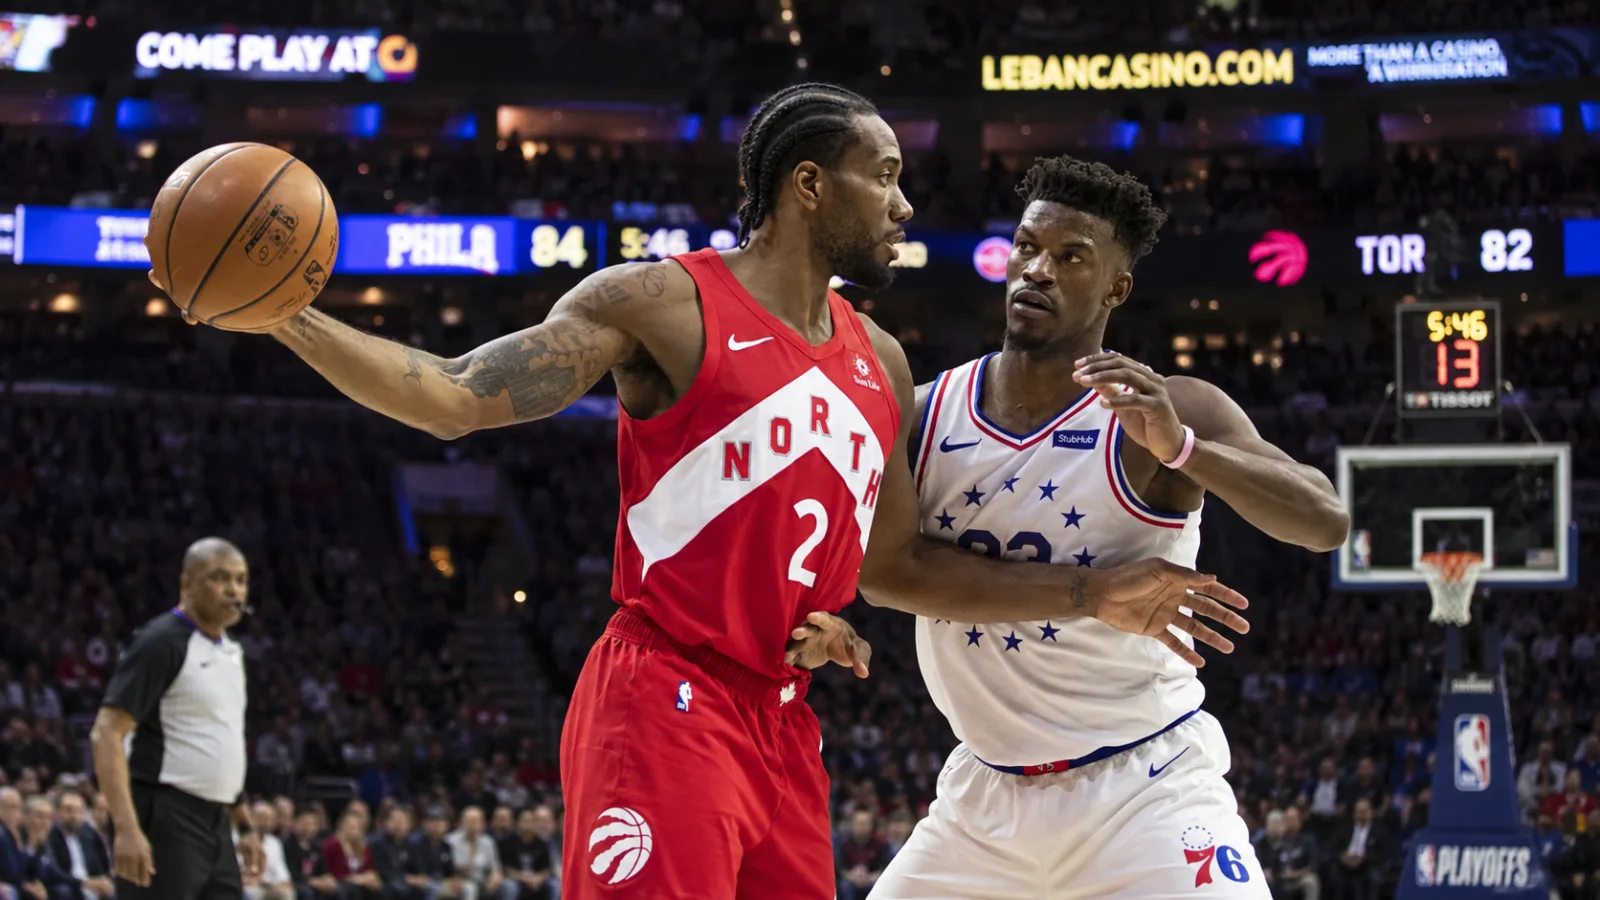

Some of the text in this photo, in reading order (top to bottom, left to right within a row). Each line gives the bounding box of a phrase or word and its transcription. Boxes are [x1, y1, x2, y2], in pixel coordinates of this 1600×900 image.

[136, 31, 378, 73] COME PLAY AT
[982, 48, 1294, 90] LEBANCASINO.COM
[386, 222, 499, 274] PHILA
[530, 225, 588, 269] 84
[620, 227, 690, 259] 5:46
[1355, 234, 1426, 275] TOR
[1480, 228, 1534, 272] 82
[1427, 310, 1488, 342] 5:46
[1437, 339, 1480, 388] 13
[1429, 390, 1494, 409] TISSOT
[721, 394, 883, 510] NORTH
[1058, 434, 1094, 443] StubHub
[788, 498, 829, 588] 2
[1182, 845, 1250, 888] 76
[1435, 845, 1531, 888] PLAYOFFS
